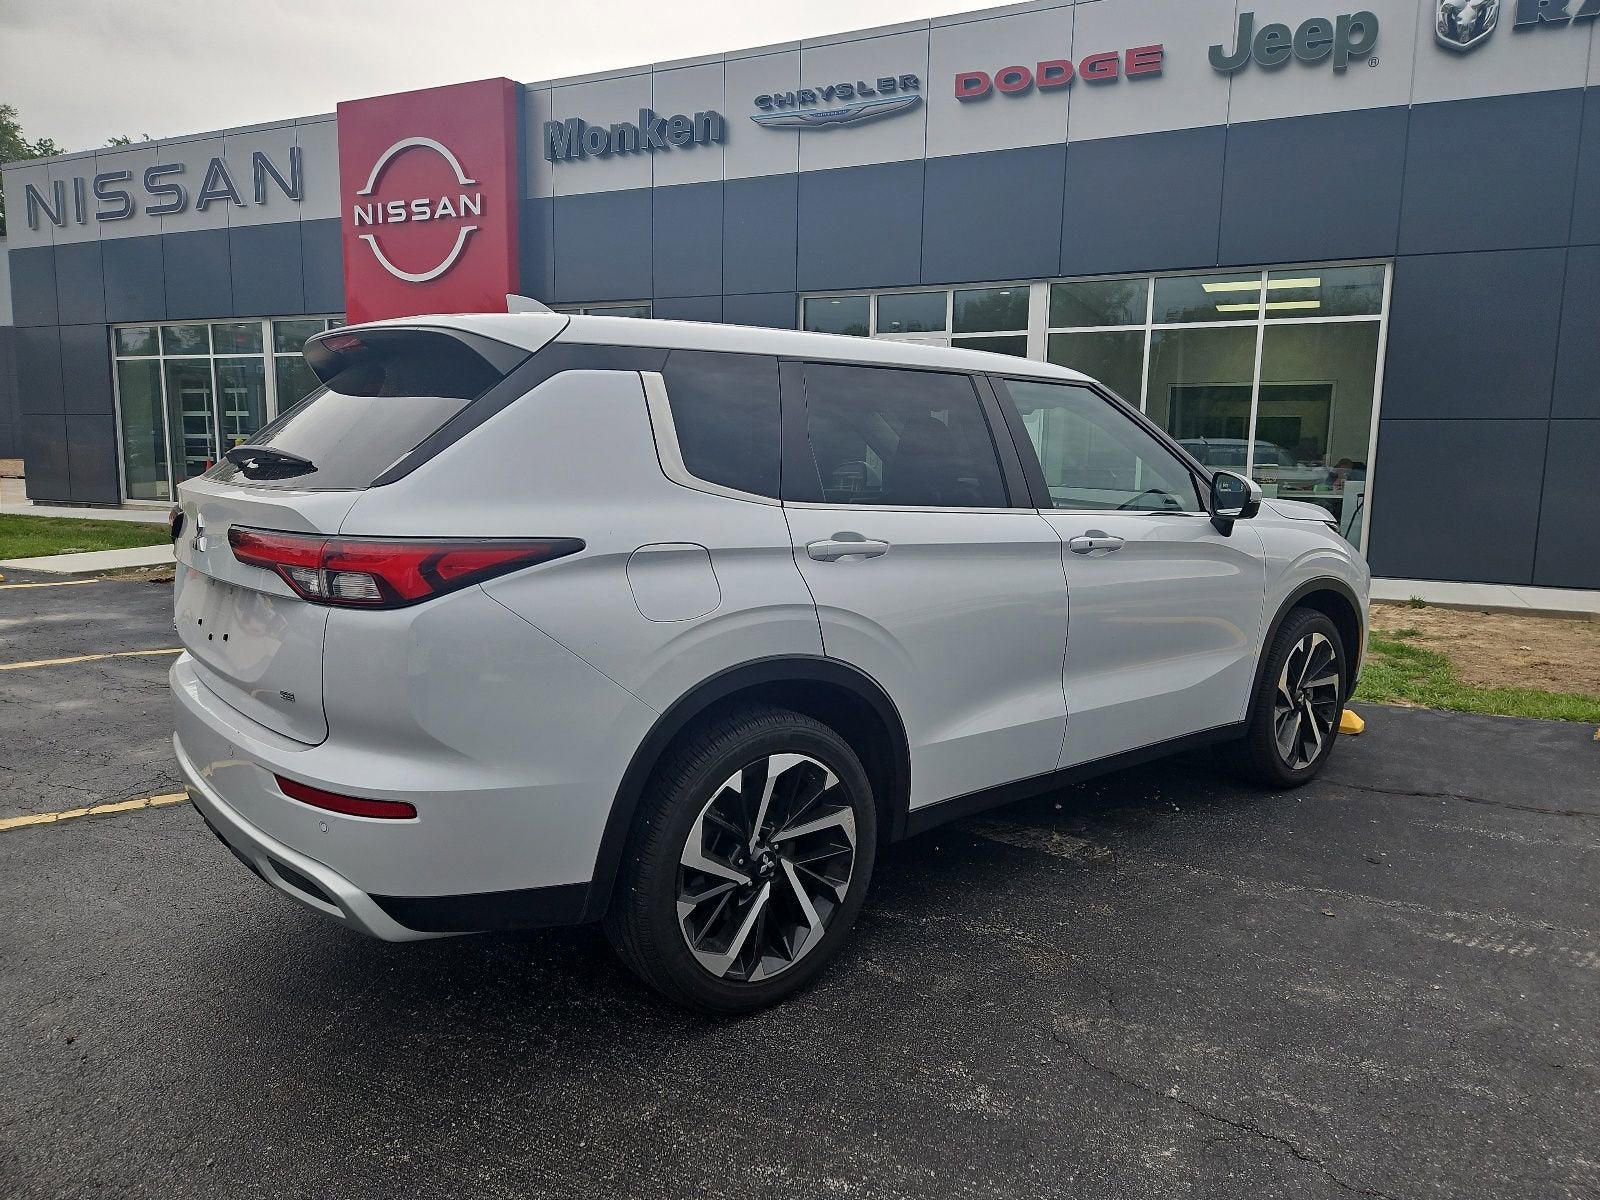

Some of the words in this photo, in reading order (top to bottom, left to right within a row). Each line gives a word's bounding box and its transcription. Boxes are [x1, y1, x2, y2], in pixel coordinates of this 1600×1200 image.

[1208, 10, 1380, 73] Jeep
[754, 73, 920, 109] CHRYSLER
[954, 44, 1164, 103] DODGE
[542, 107, 726, 164] Monken
[25, 146, 302, 230] NISSAN
[353, 192, 481, 226] NISSAN
